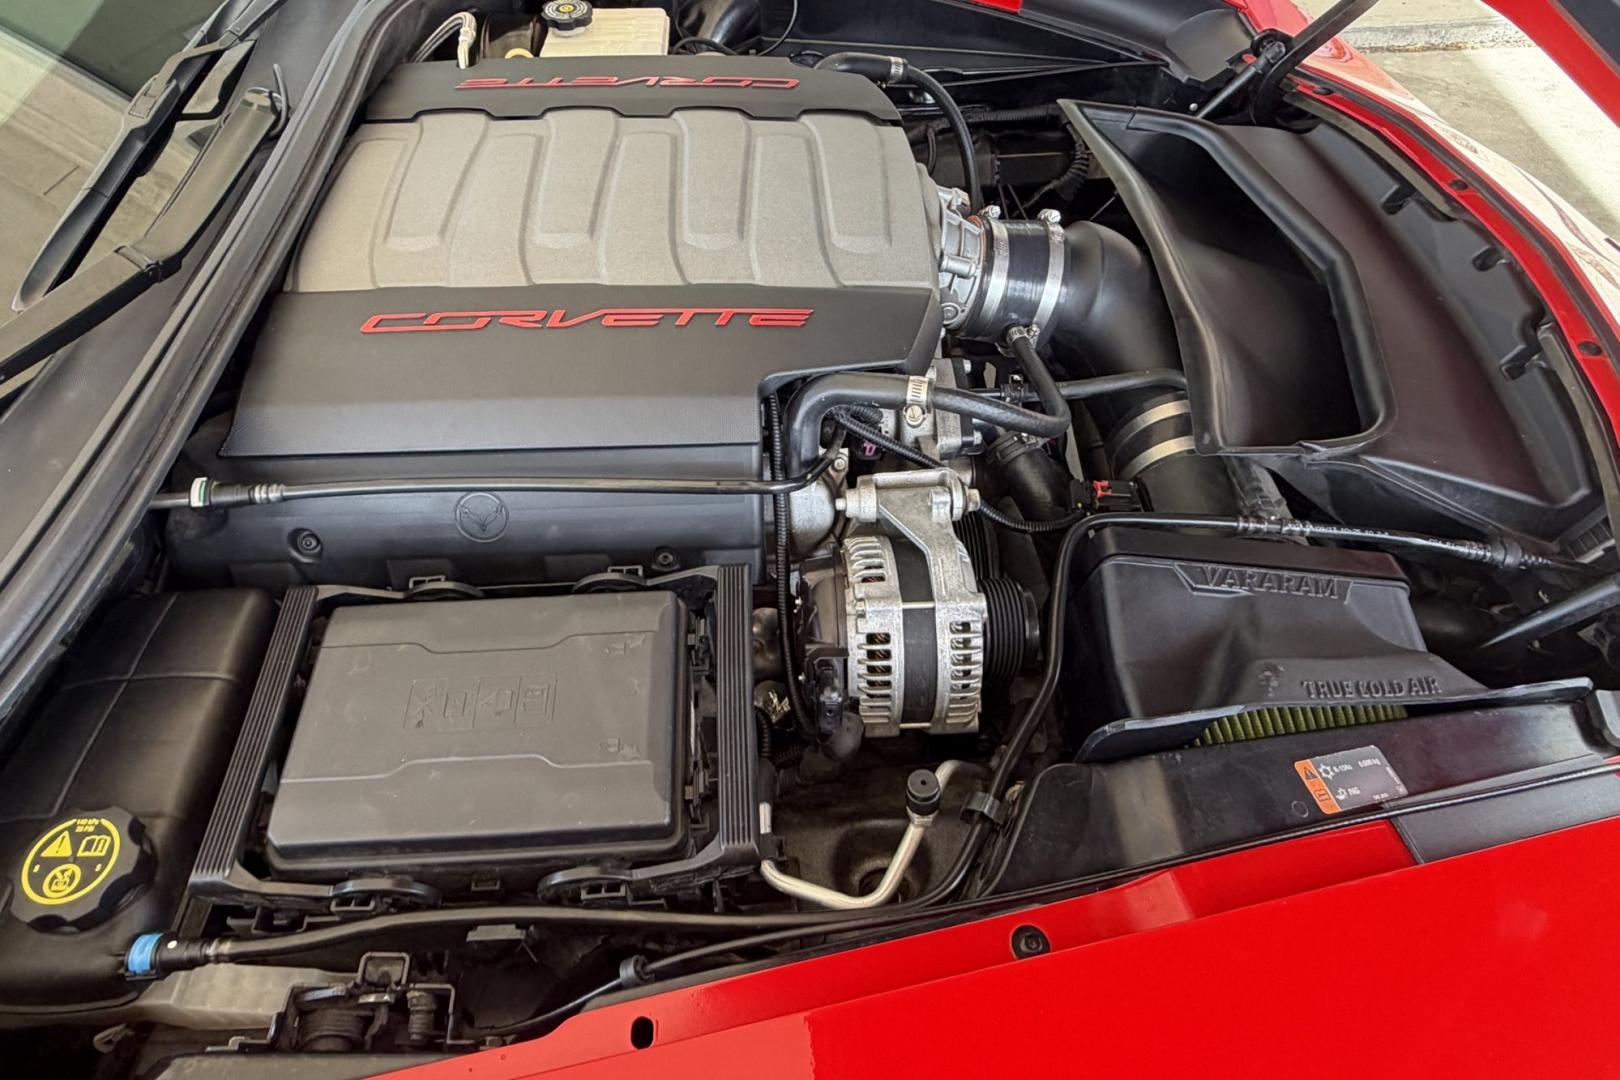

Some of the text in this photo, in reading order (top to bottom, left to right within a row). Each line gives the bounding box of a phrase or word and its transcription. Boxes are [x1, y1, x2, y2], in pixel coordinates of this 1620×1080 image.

[454, 76, 800, 90] CORVETTE
[359, 307, 815, 335] CORVETTE
[1203, 565, 1338, 600] VARARAM
[1300, 676, 1443, 699] TRUE COLD AIR
